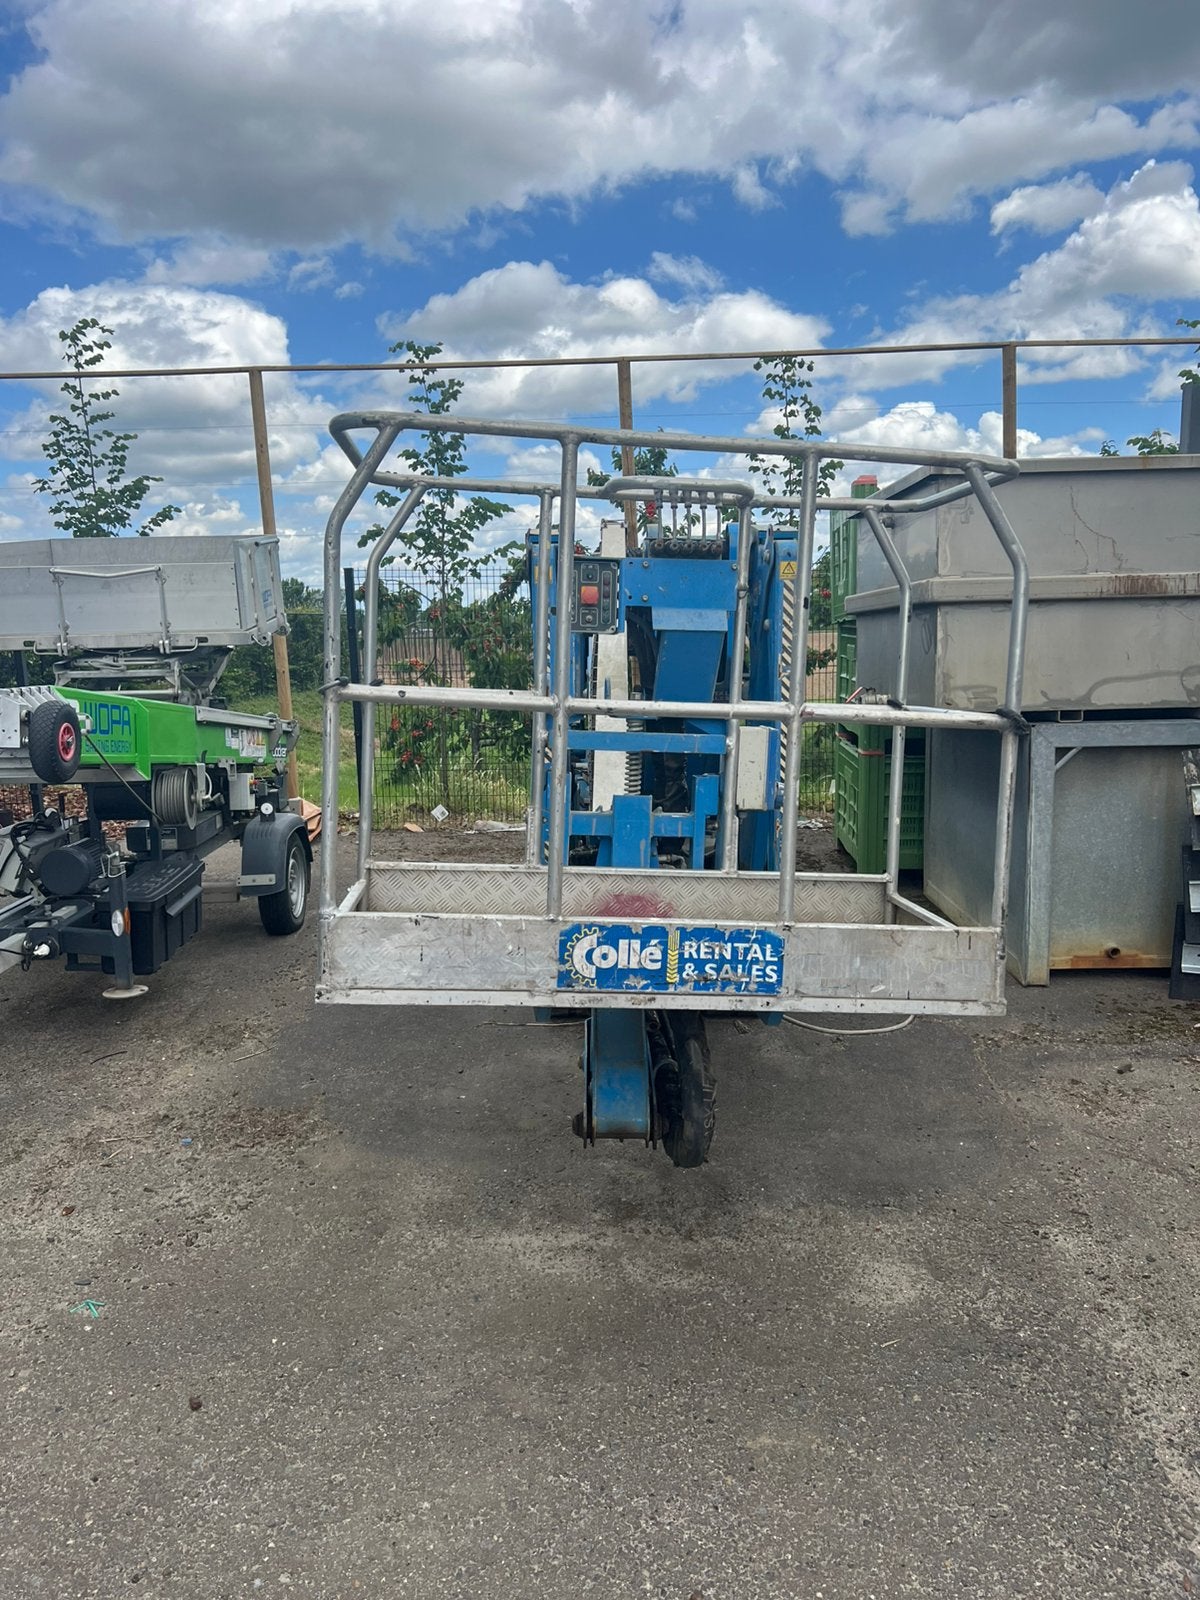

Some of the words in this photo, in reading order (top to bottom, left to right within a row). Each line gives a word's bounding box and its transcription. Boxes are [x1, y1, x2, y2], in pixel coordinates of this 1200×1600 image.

[572, 933, 663, 979] Collé
[683, 940, 779, 962] RENTAL
[682, 963, 699, 980] &
[704, 963, 779, 983] SALES
